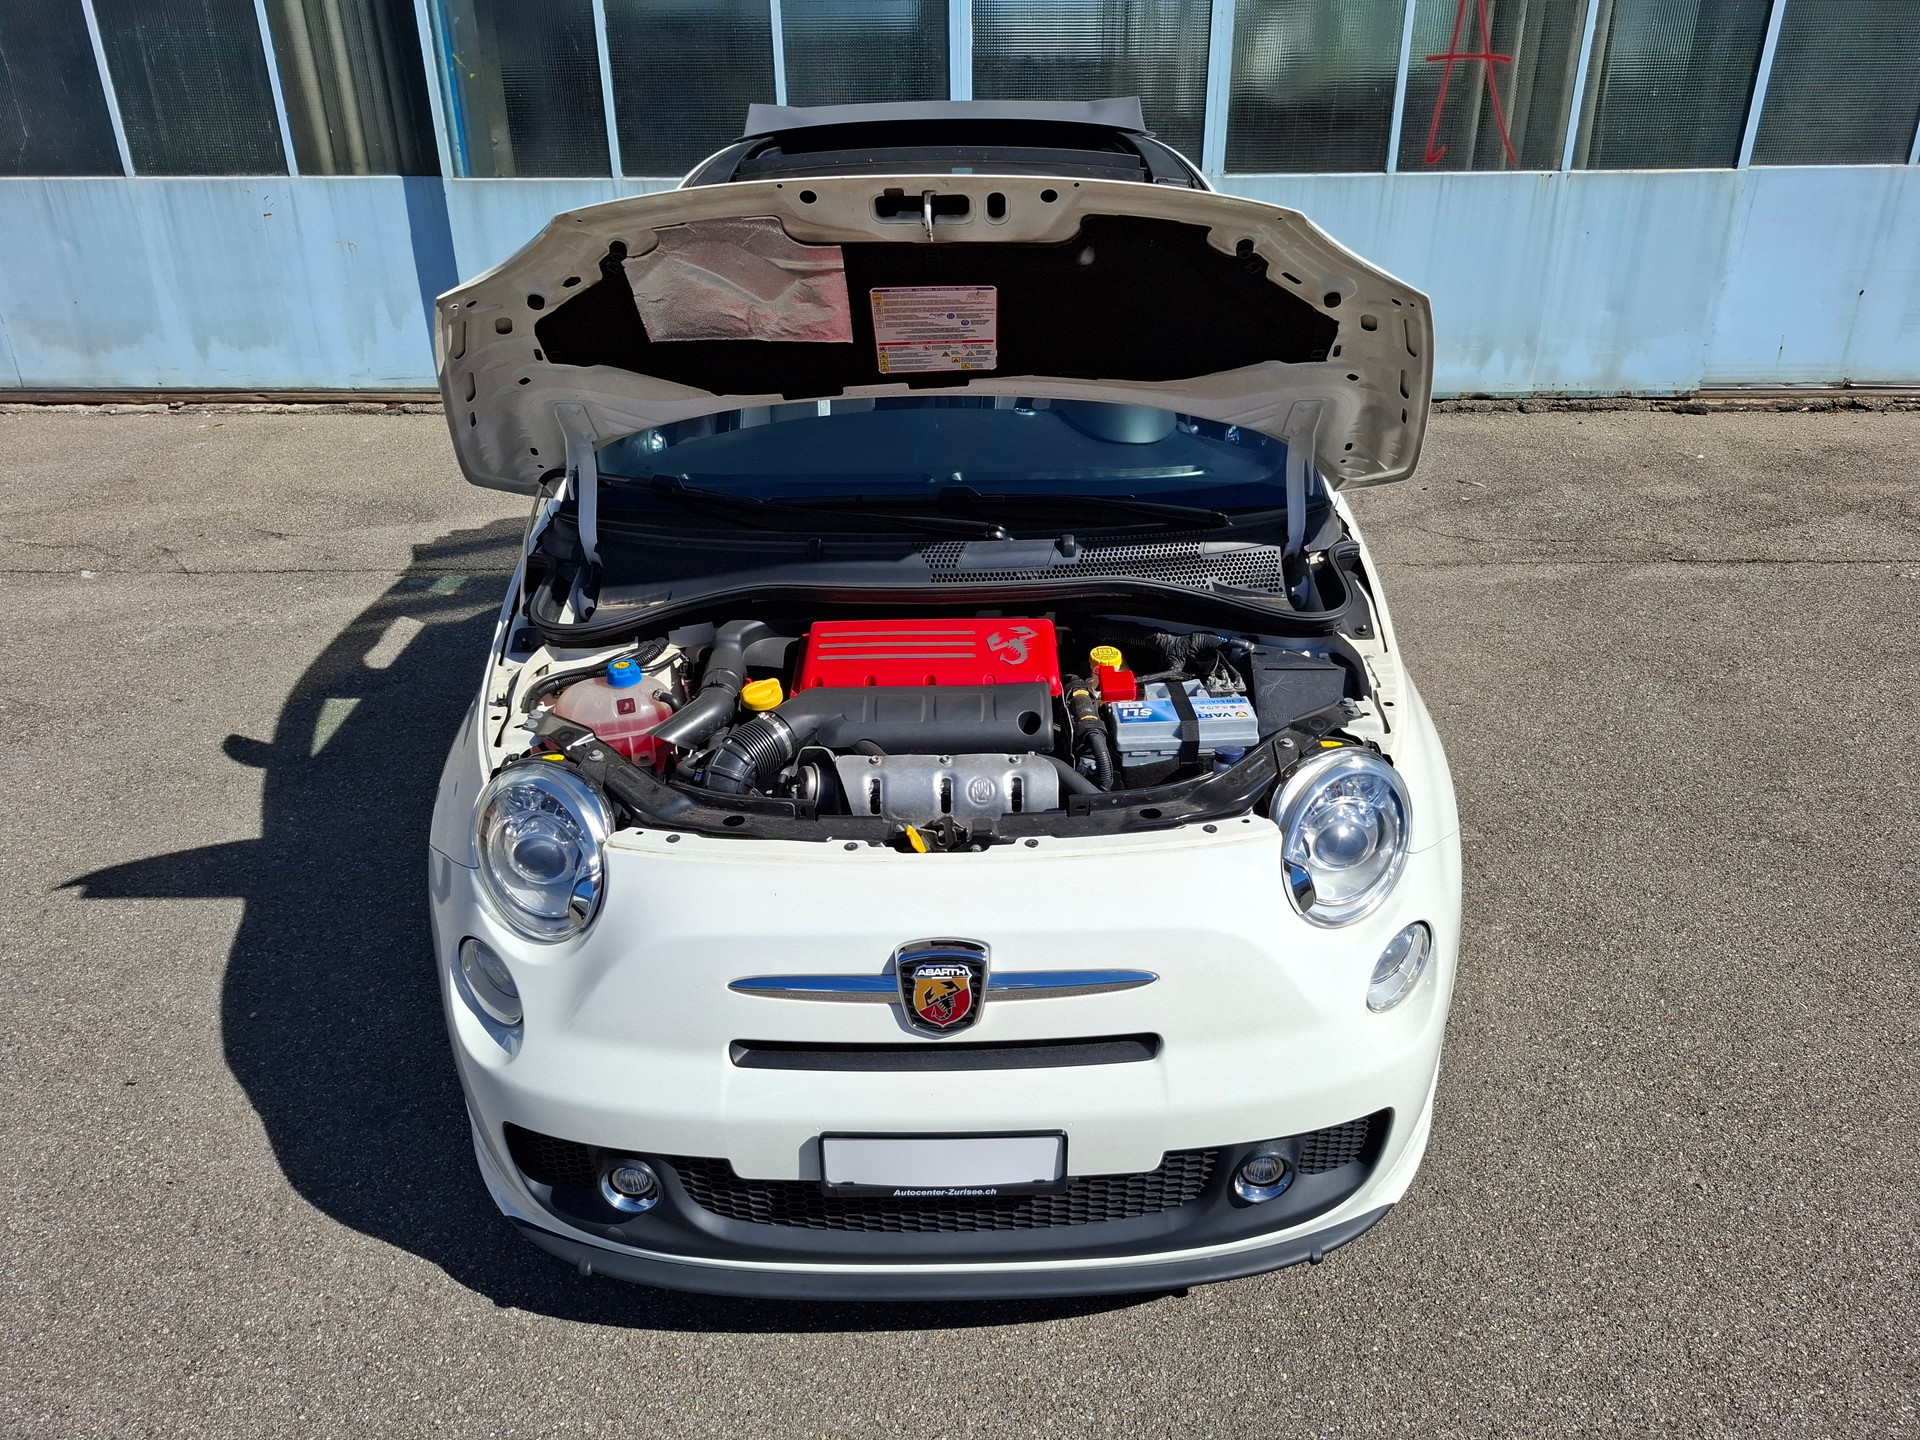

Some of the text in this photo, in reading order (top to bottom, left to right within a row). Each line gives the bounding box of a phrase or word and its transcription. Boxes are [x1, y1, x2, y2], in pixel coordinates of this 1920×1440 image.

[1122, 708, 1152, 717] SLI
[917, 968, 966, 976] ABARTH
[893, 1187, 998, 1197] Autocenter-Zurisee.ch
